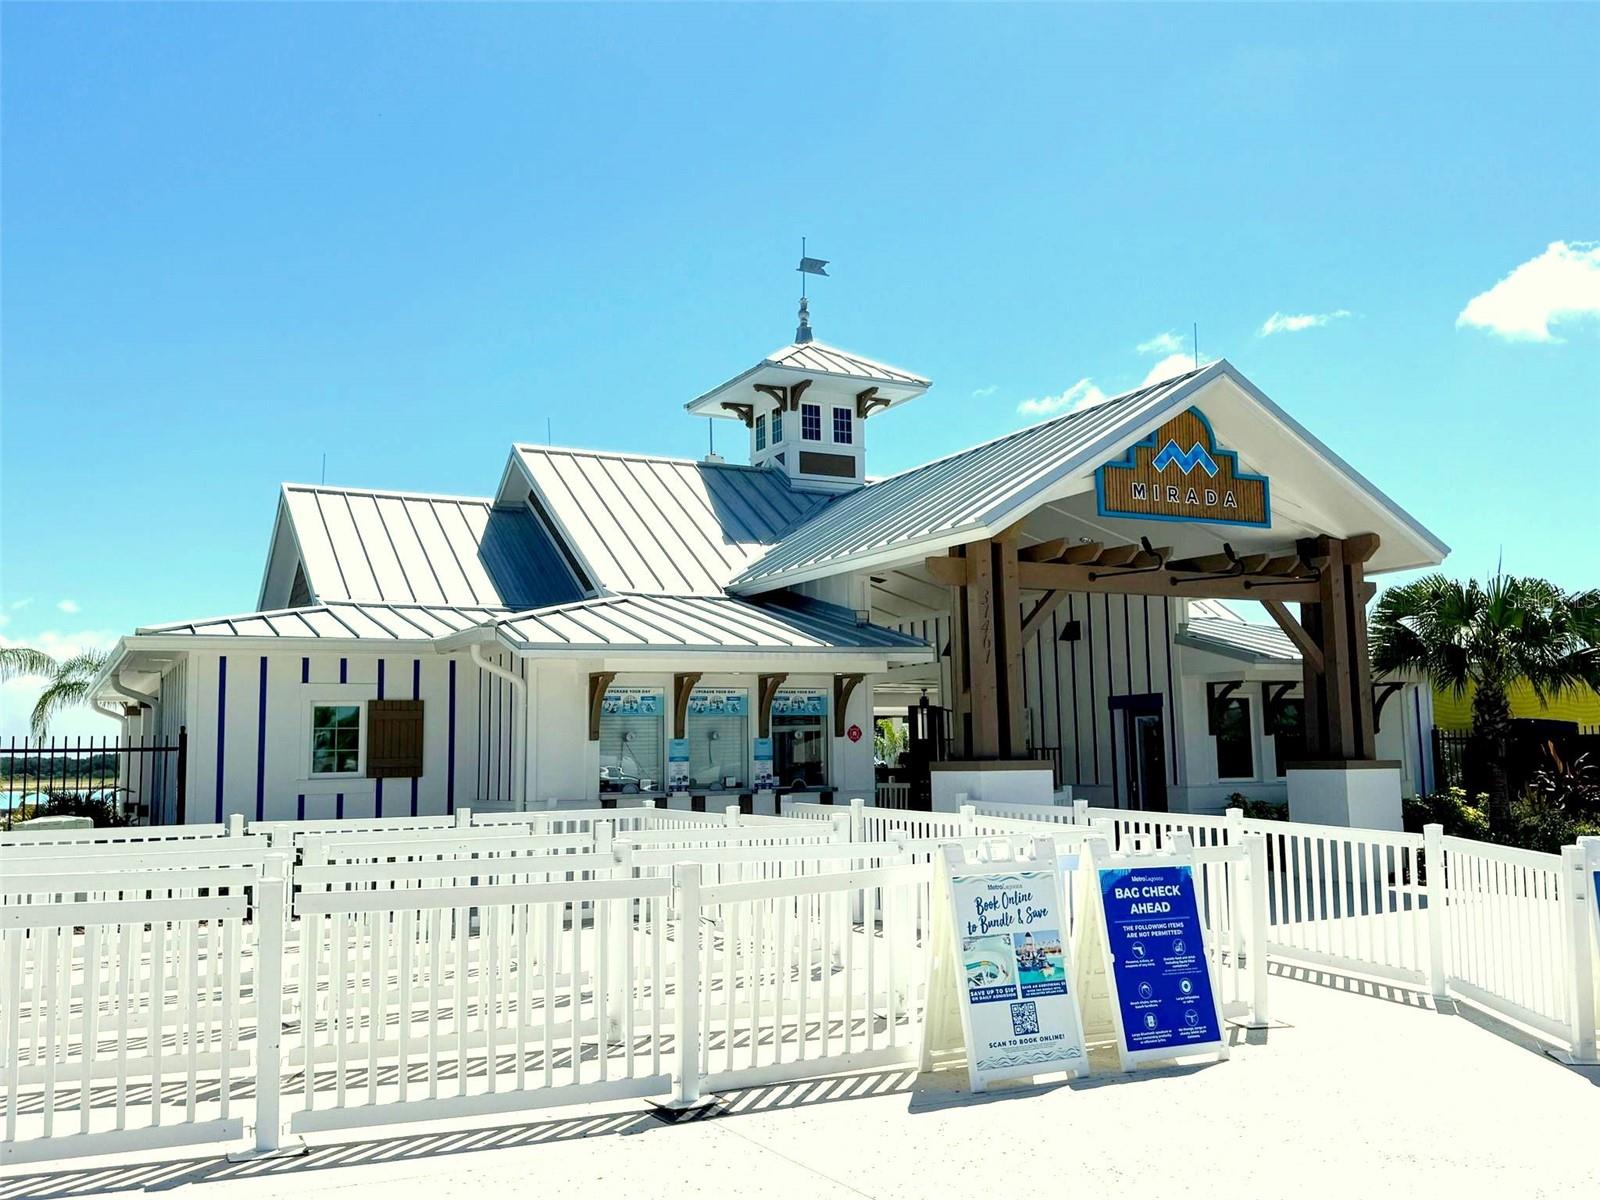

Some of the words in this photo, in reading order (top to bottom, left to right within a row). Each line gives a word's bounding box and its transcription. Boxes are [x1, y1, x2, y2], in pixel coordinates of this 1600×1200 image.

[1132, 482, 1237, 508] MIRADA
[1114, 887, 1140, 899] BAG
[1142, 885, 1181, 897] CHECK
[974, 895, 1000, 916] Book
[1001, 891, 1034, 910] Online
[1130, 901, 1171, 915] AHEAD
[967, 921, 978, 935] to
[978, 912, 1015, 934] Bundle
[1017, 908, 1024, 924] &
[1026, 906, 1049, 924] Save
[1134, 923, 1167, 931] FOLLOWING
[970, 989, 986, 997] SAVE
[988, 1041, 1007, 1049] SCAN
[1019, 1037, 1038, 1045] BOOK
[1039, 1033, 1065, 1042] ONLINE!
